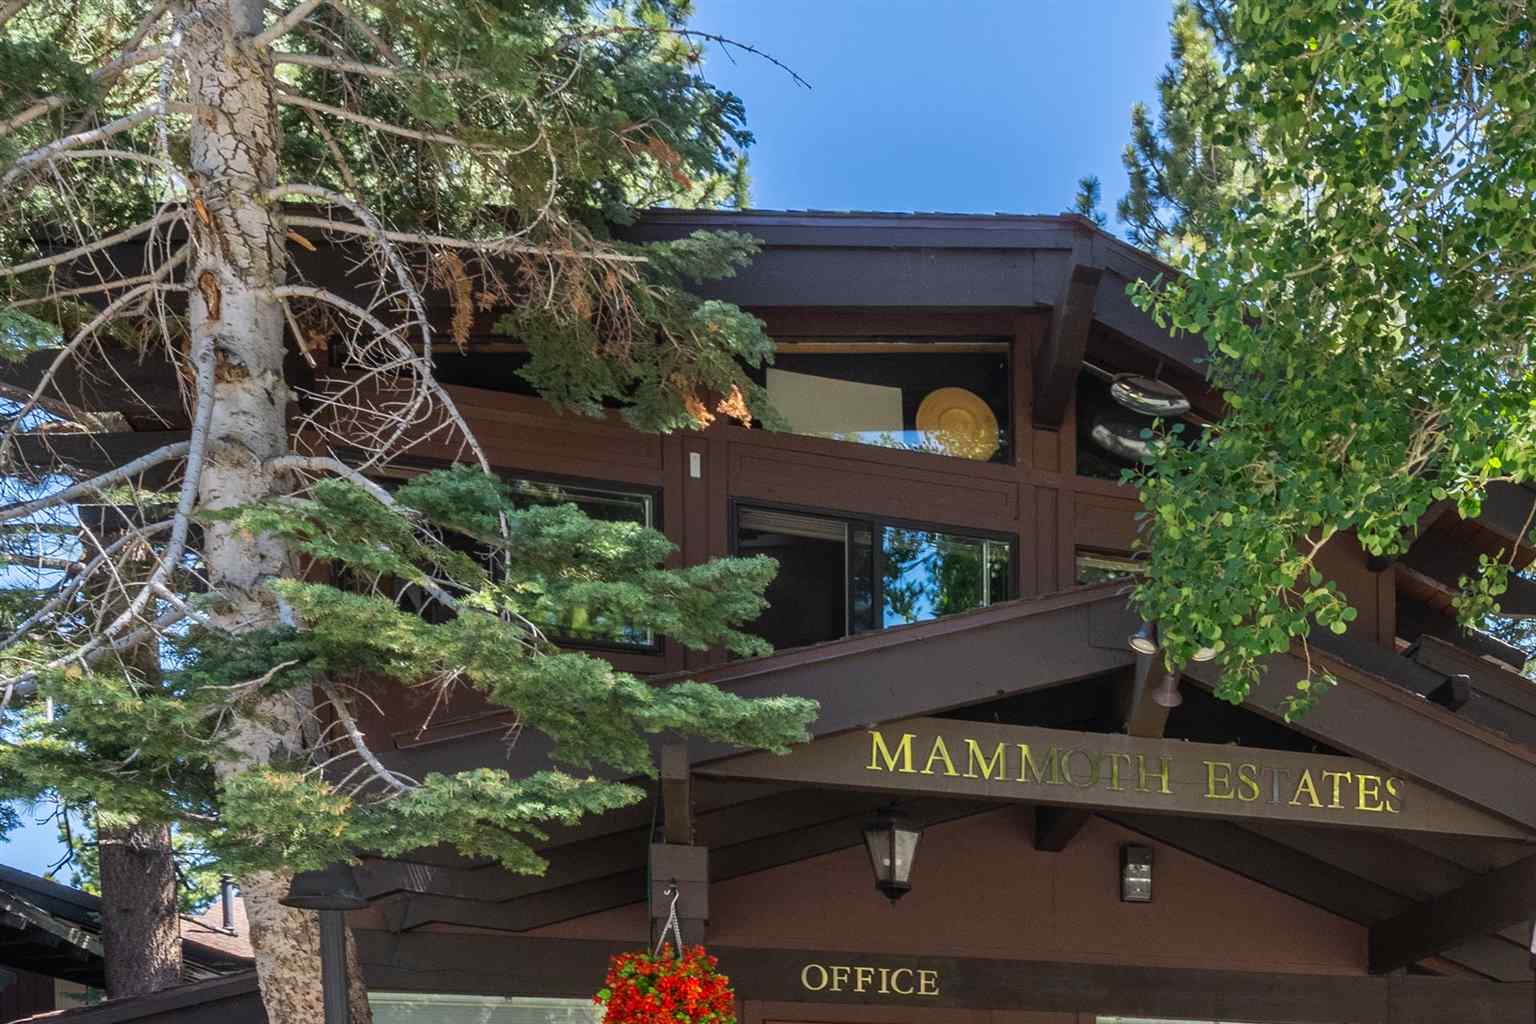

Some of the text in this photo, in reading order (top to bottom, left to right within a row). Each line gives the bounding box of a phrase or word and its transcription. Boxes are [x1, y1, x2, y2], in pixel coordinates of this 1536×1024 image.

[866, 730, 1404, 814] MAMMOTH ESTATES
[801, 964, 940, 995] OFFICE
